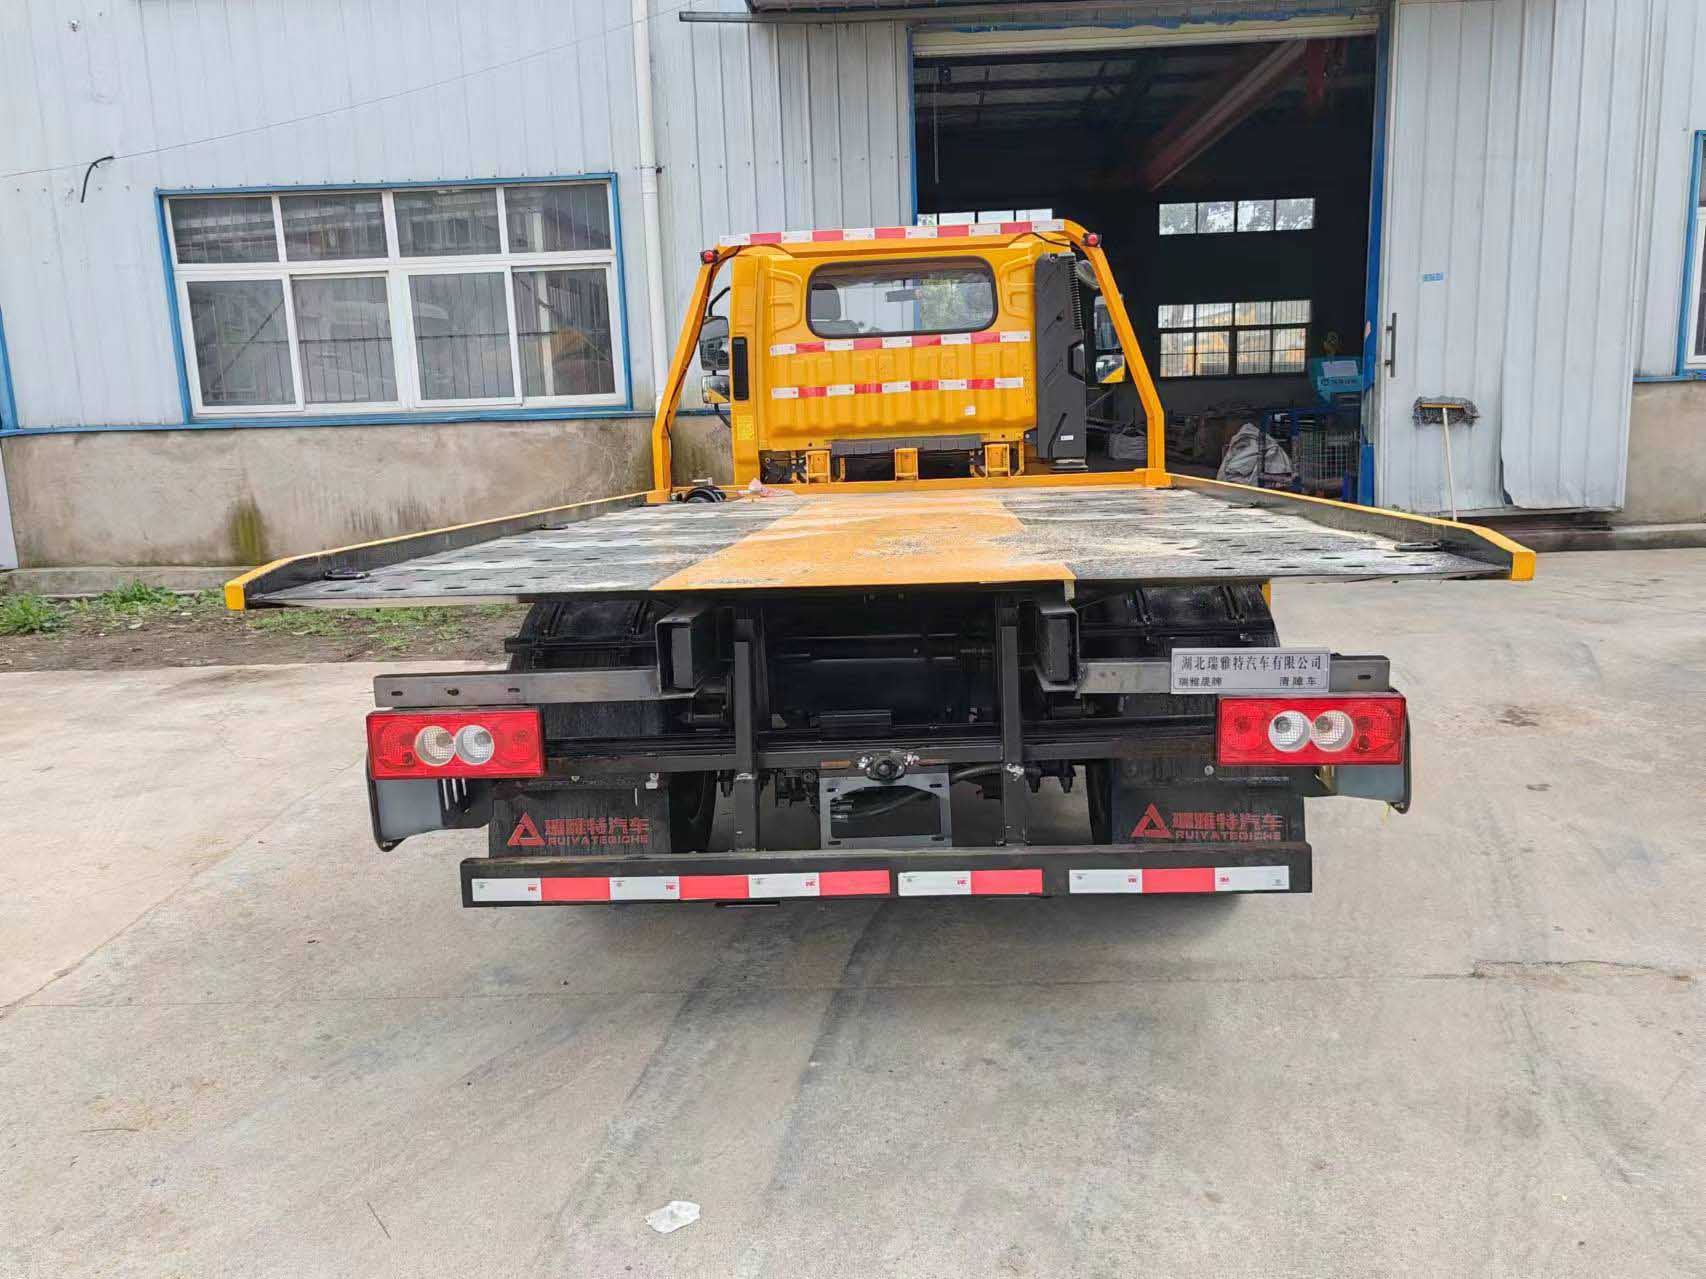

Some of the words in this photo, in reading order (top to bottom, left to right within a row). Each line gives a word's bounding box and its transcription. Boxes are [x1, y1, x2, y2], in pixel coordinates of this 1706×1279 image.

[1181, 655, 1321, 670] 湖北瑞雅特汽车有限公司
